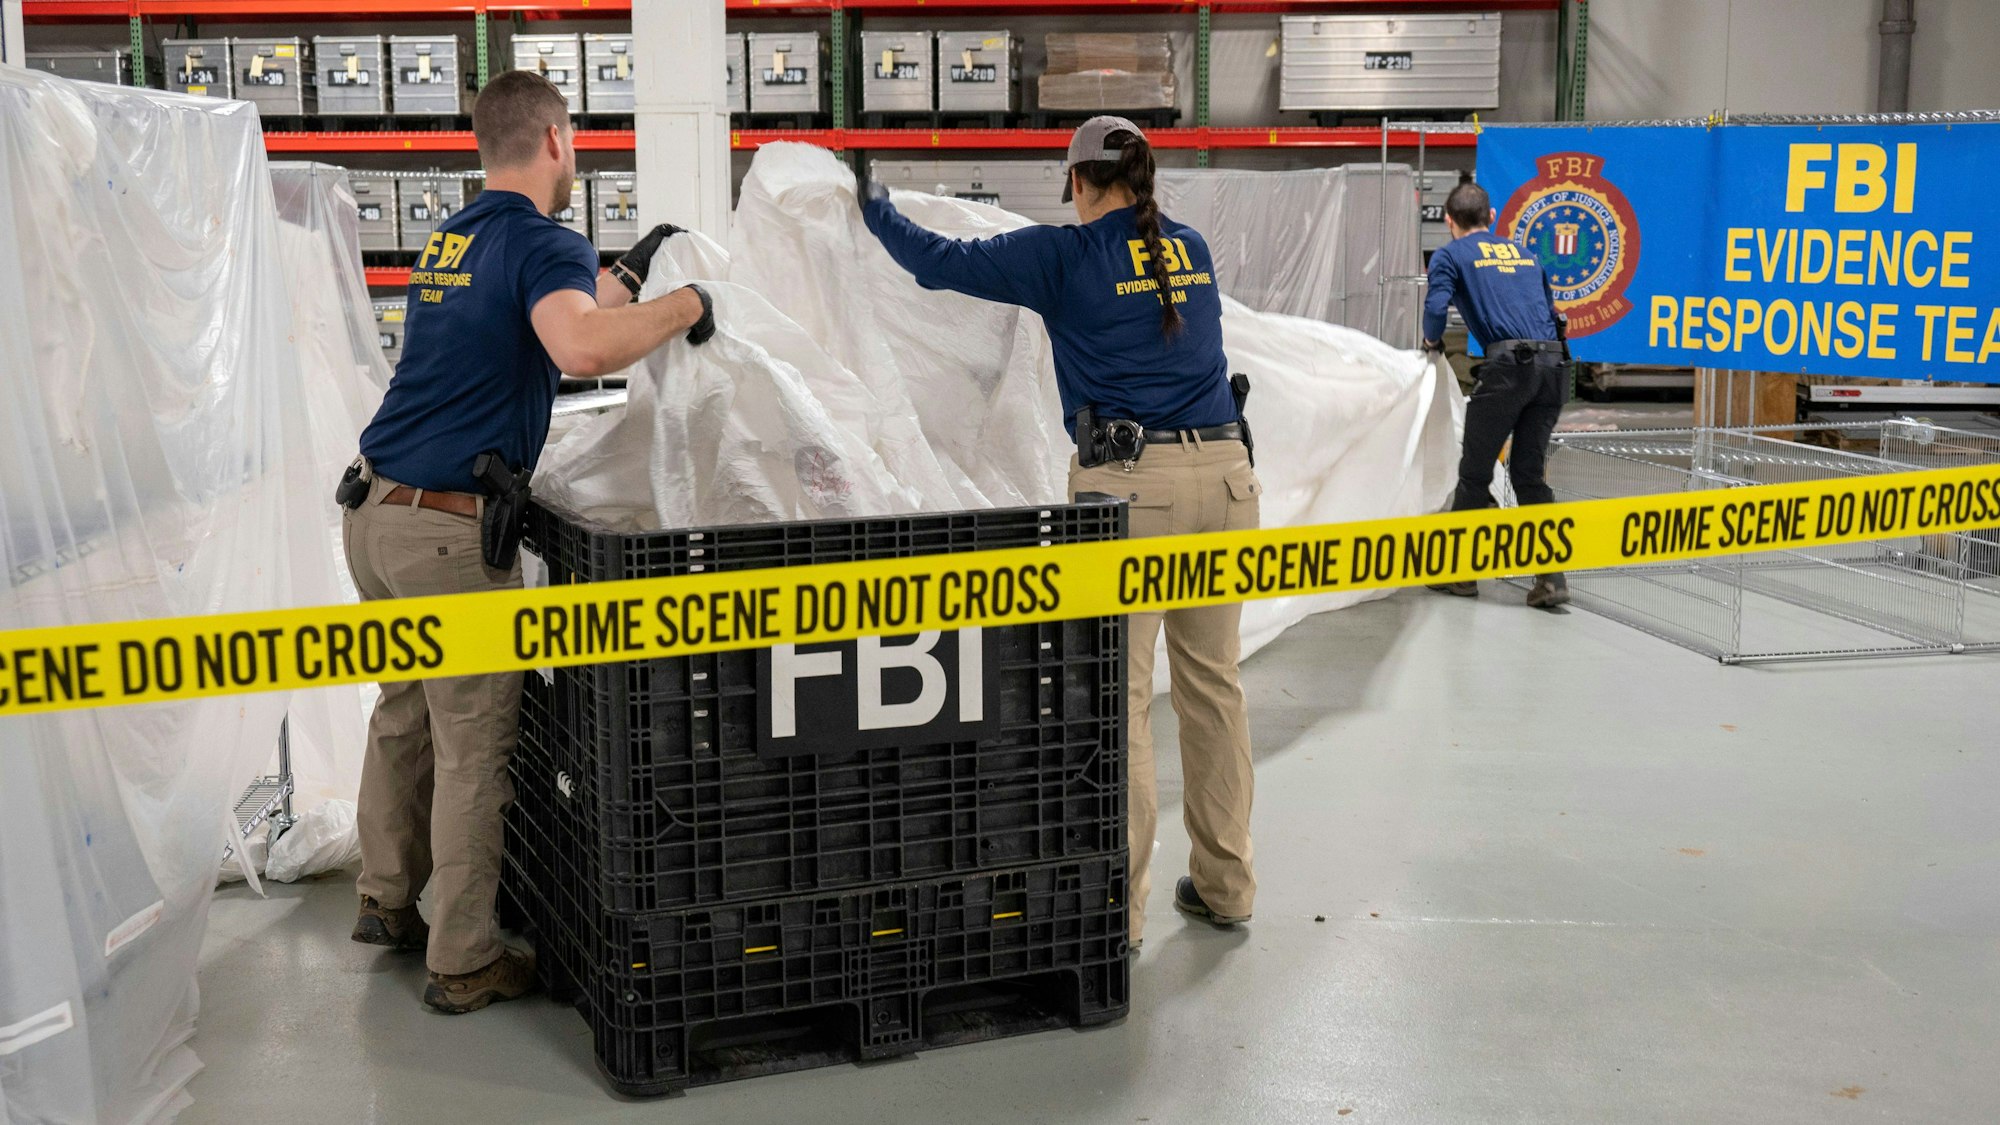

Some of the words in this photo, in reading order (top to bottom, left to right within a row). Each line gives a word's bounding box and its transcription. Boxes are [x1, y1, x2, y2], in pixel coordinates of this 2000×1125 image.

[1546, 157, 1595, 179] FBI
[1785, 142, 1918, 214] FBI
[1522, 199, 1550, 225] DEPT.
[1552, 192, 1569, 202] OF
[1572, 193, 1614, 226] JUSTICE
[419, 231, 475, 269] FBI
[1127, 238, 1193, 276] FBI
[1478, 242, 1521, 259] FBI
[1563, 290, 1577, 300] OF
[1579, 229, 1620, 298] INVESTIGATION
[1725, 227, 1973, 288] EVIDENCE
[420, 288, 444, 303] TEAM
[434, 272, 472, 286] RESPONSE
[1116, 278, 1160, 295] EVIDEN
[1169, 273, 1212, 287] RESPONSE
[1157, 290, 1187, 306] TAM
[1649, 295, 1899, 360] RESPONSE
[1620, 505, 1715, 558] CRIME
[1718, 496, 1810, 549] SCENE
[1815, 491, 1856, 539] DO
[1858, 486, 1916, 534] NOT
[1917, 477, 2000, 529] CROSS
[1118, 548, 1228, 606] CRIME
[1234, 538, 1341, 595] SCENE
[1350, 533, 1396, 584] DO
[1401, 527, 1467, 579] NOT
[1470, 517, 1575, 573] CROSS
[513, 598, 645, 662] CRIME
[655, 586, 781, 649] SCENE
[794, 580, 847, 636] DO
[856, 573, 932, 630] NOT
[938, 562, 1061, 623] CROSS
[119, 636, 184, 697] DO
[194, 627, 284, 690] NOT
[294, 614, 444, 681] CROSS
[771, 626, 983, 738] FBI
